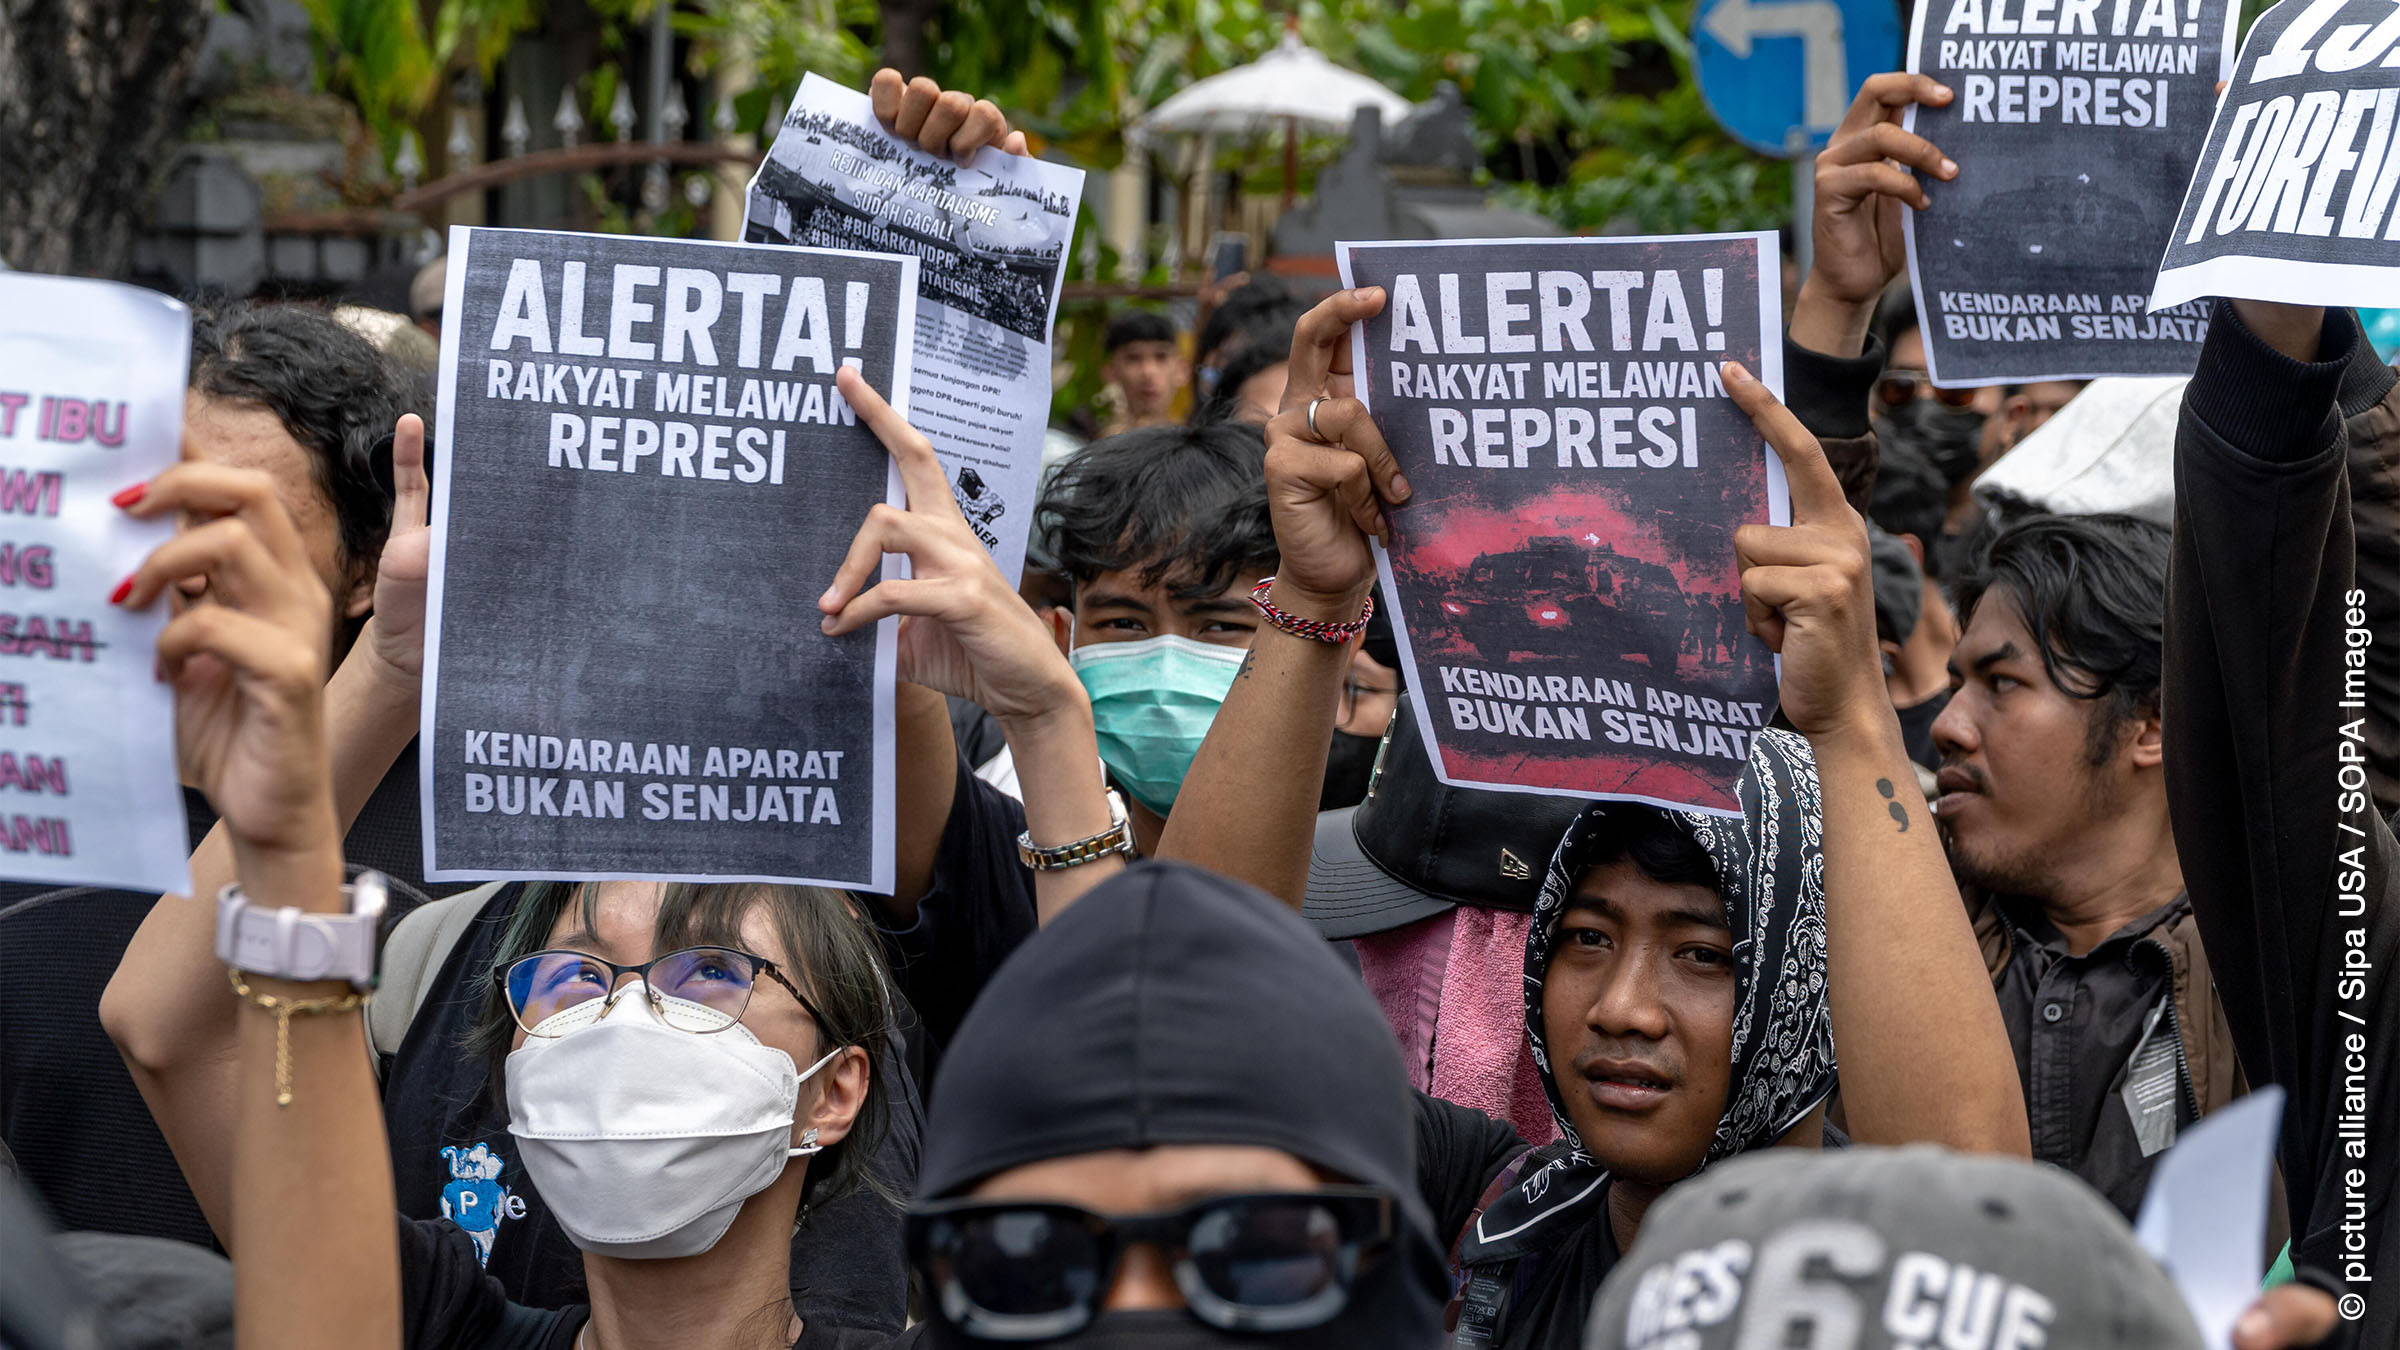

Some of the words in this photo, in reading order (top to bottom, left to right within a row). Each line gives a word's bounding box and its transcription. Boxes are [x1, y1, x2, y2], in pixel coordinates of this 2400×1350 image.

[1939, 40, 2047, 70] RAKYAT
[2056, 41, 2198, 74] MELAWAN
[1962, 74, 2168, 128] REPRESI
[829, 150, 875, 182] REJIM
[874, 169, 906, 194] DAN
[906, 179, 1000, 227] KAPITALISME
[2184, 87, 2400, 245] FOREV
[842, 214, 955, 270] #BUBARKANDPR
[853, 190, 901, 223] SUDAH
[902, 208, 954, 242] GAGAL!
[490, 258, 870, 374] ALERTA!
[1389, 268, 1726, 354] ALERTA!
[1939, 291, 2101, 315] KENDARAAN
[1944, 315, 2061, 342] BUKAN
[487, 359, 641, 409] RAKYAT
[655, 372, 856, 427] MELAWAN
[913, 367, 939, 379] semua
[941, 374, 980, 390] tunjangan
[936, 391, 952, 402] DPR
[953, 396, 979, 410] seperti
[981, 405, 996, 415] gaji
[1391, 361, 1530, 400] RAKYAT
[1544, 361, 1729, 399] MELAWAN
[40, 394, 127, 448] IBU
[1429, 406, 1698, 469] REPRESI
[548, 412, 786, 485] REPRESI
[967, 514, 998, 549] NER
[1439, 666, 1637, 709] KENDARAAN
[1646, 687, 1762, 727] APARAT
[1448, 697, 1591, 741] BUKAN
[465, 730, 690, 777] KENDARAAN
[702, 747, 844, 780] APARAT
[465, 773, 625, 819] BUKAN
[641, 782, 841, 825] SENJATA
[460, 1191, 478, 1215] P
